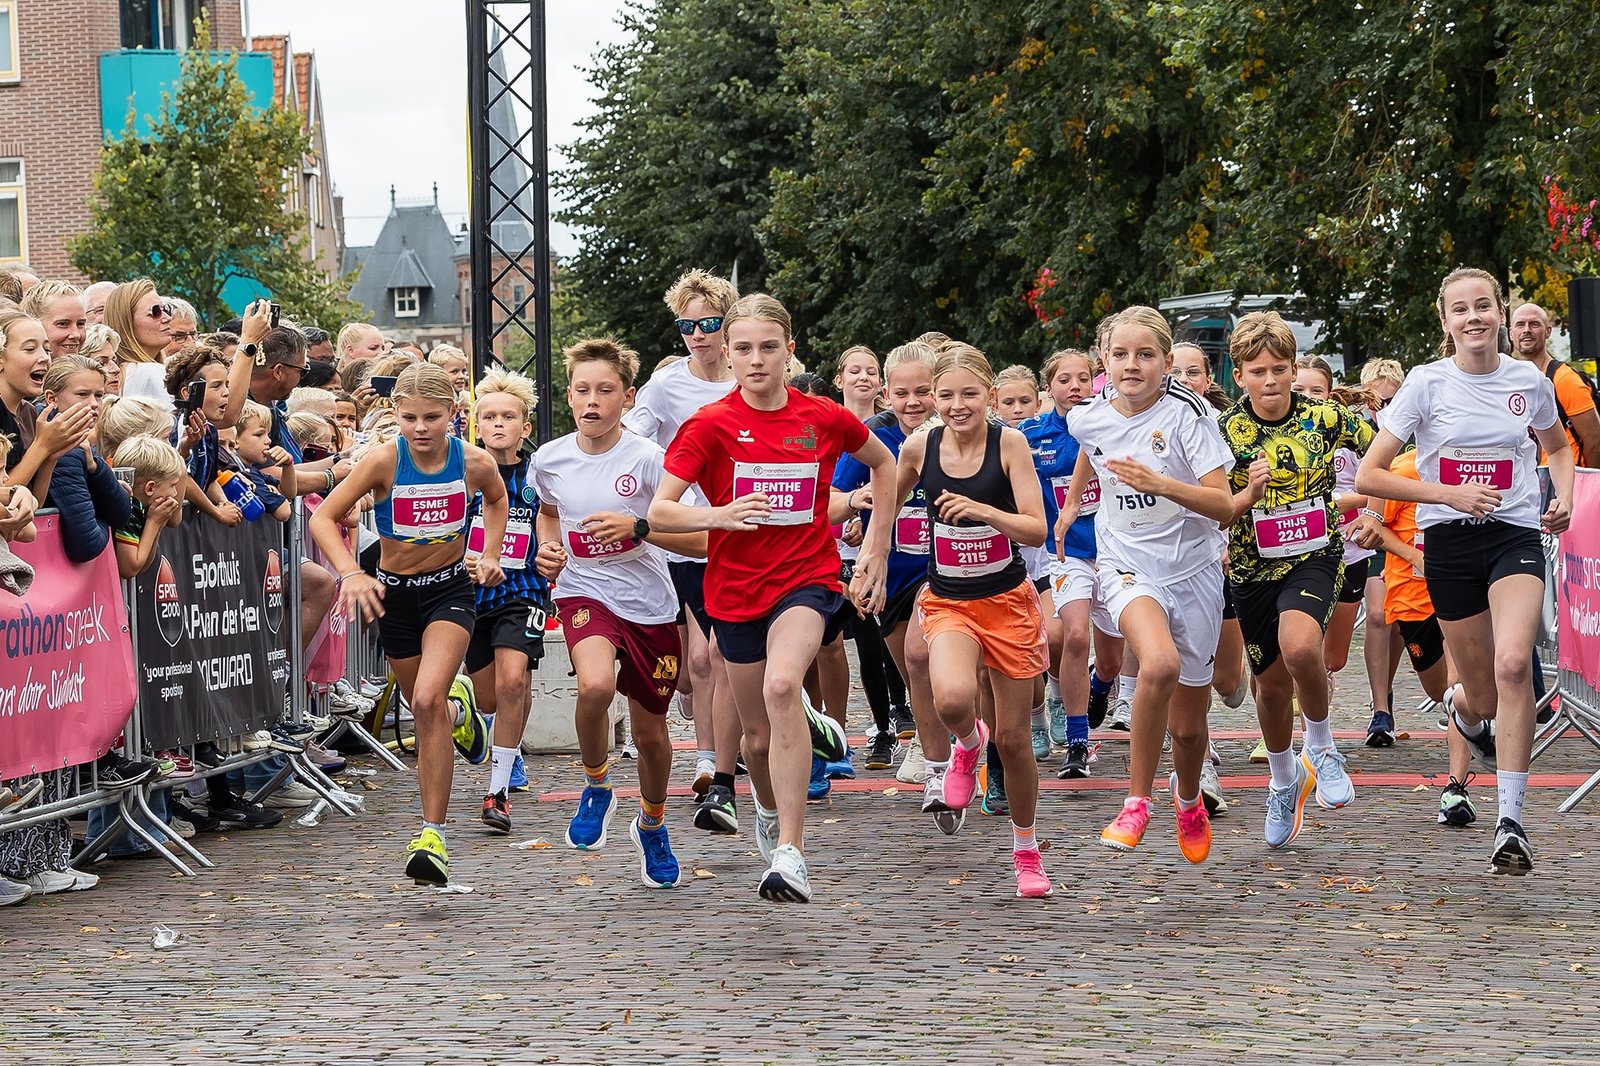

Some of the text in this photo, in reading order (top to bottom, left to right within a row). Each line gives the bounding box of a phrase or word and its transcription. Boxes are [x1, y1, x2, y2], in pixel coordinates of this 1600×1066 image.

[1456, 463, 1497, 474] JOLEIN
[753, 481, 802, 492] BENTHE
[412, 498, 449, 510] ESMEE
[769, 494, 794, 508] 218
[1115, 493, 1157, 511] 7510
[412, 509, 449, 524] 7420
[1275, 516, 1307, 530] THIJS
[1278, 526, 1309, 543] 2241
[587, 541, 624, 555] 2243
[951, 539, 993, 551] SOPHIE
[957, 552, 988, 564] 2115
[192, 551, 241, 600] Sporthuis
[405, 567, 452, 588] NIKE
[161, 602, 181, 618] 2000
[222, 601, 239, 636] der
[525, 605, 547, 632] 10
[652, 655, 678, 680] 19
